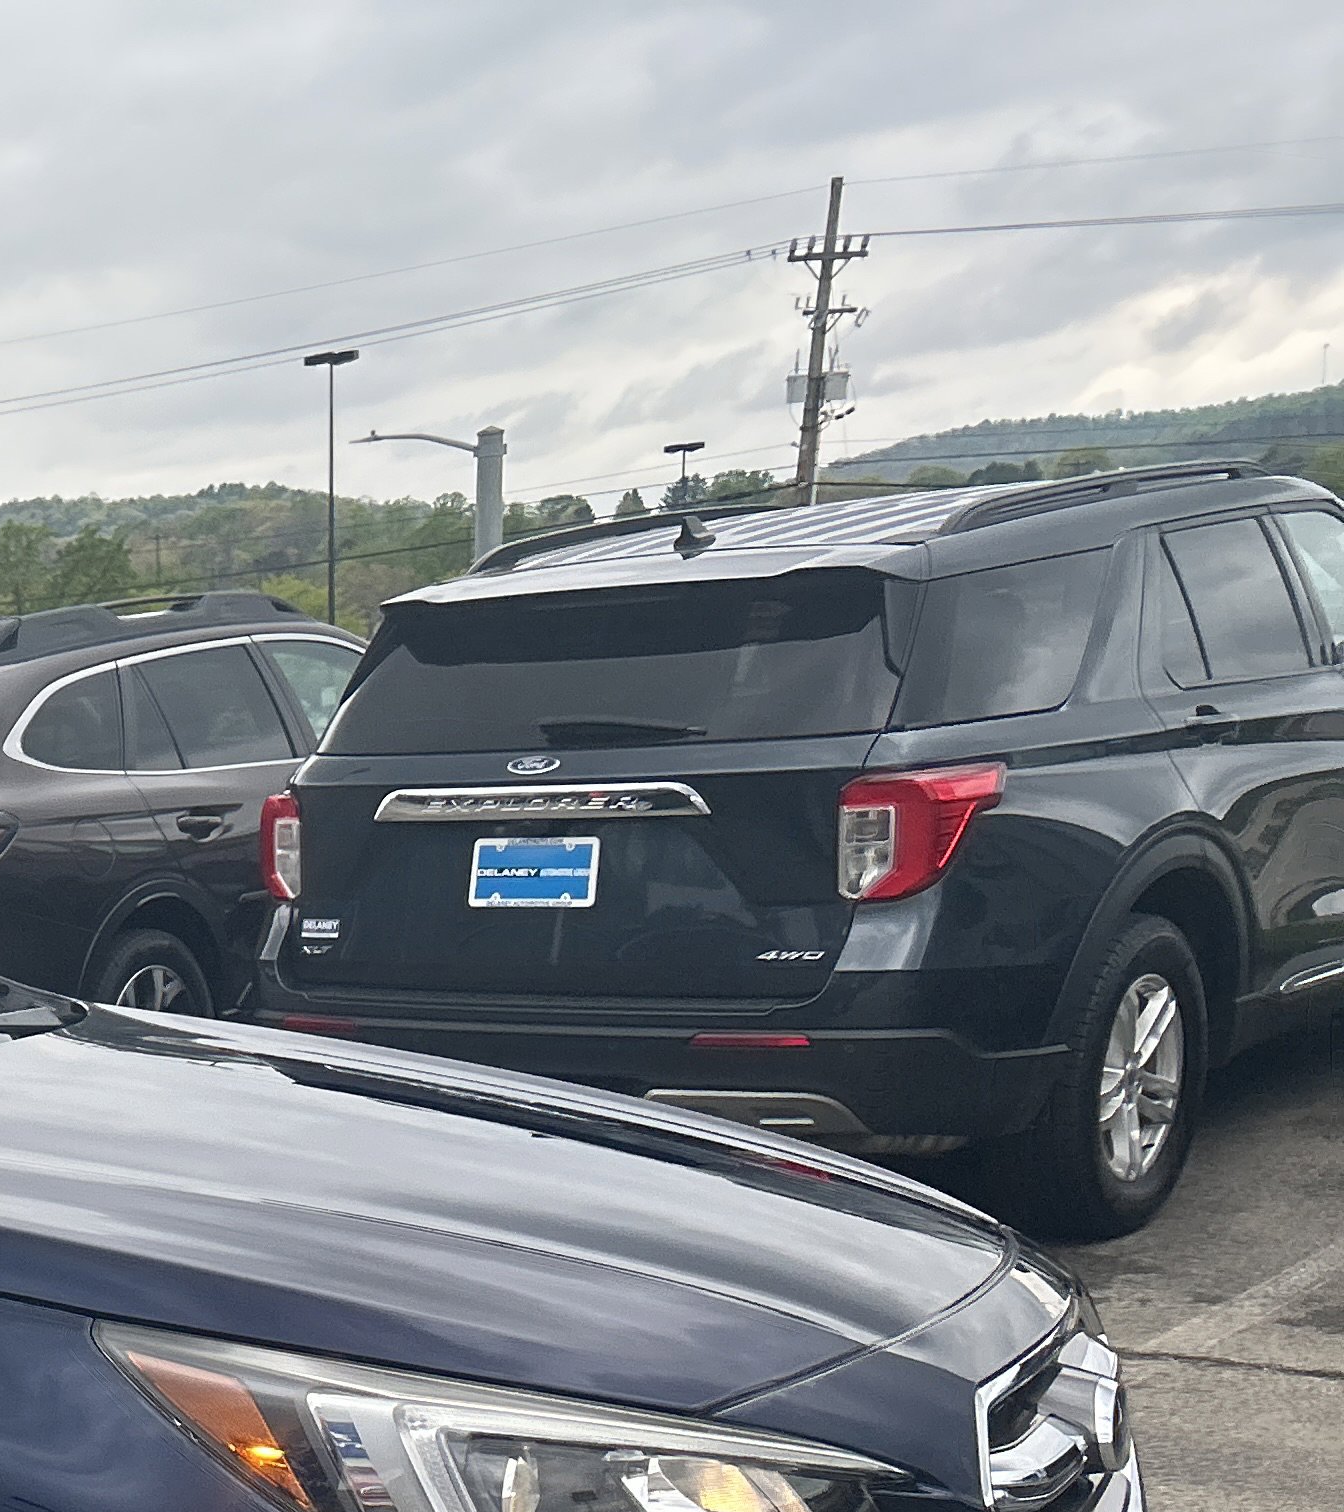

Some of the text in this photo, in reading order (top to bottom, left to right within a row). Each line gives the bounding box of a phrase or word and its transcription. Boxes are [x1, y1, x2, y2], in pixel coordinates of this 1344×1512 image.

[420, 796, 639, 814] EXPLORER
[477, 868, 538, 877] DELANEY
[303, 920, 339, 930] DELANEY
[301, 945, 333, 955] XLT
[756, 950, 825, 961] 4WD
